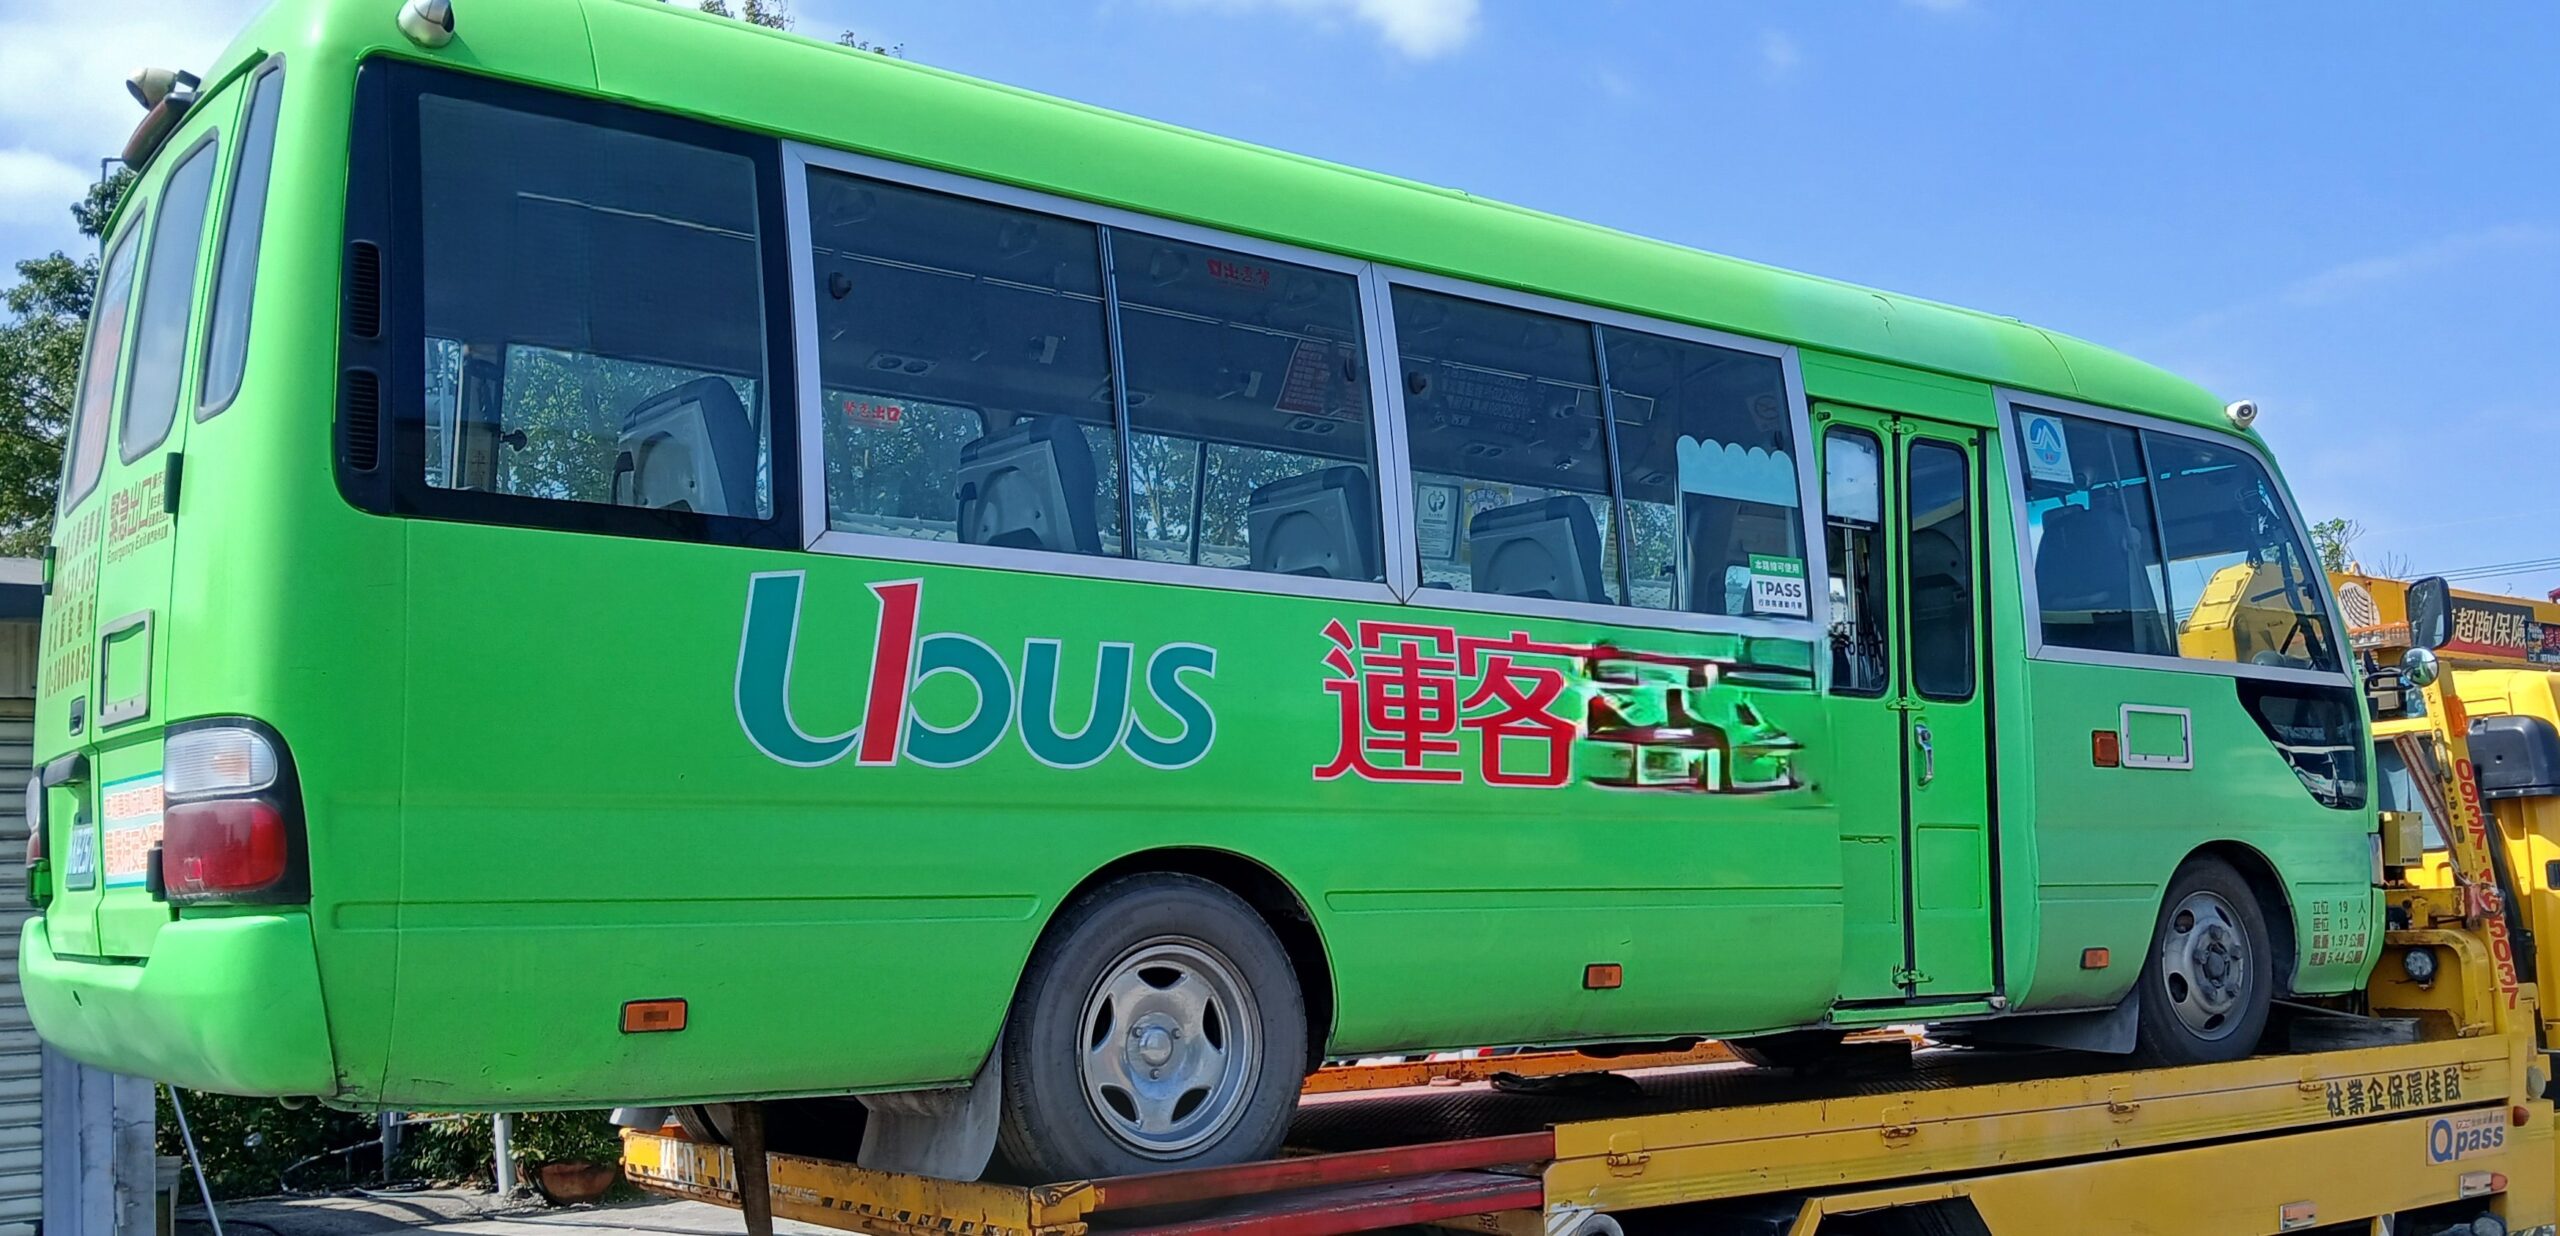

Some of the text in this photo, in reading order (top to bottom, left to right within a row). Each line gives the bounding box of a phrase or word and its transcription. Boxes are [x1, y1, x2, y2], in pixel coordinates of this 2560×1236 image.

[108, 476, 152, 547] 緊急出口
[107, 541, 135, 565] Emergency
[1756, 581, 1802, 598] TPASS
[2451, 607, 2528, 650] 超跑保險
[734, 569, 1218, 770] Ubus
[2312, 899, 2366, 915] 立位 19 人
[2339, 918, 2349, 930] 13
[2358, 917, 2366, 931] 人
